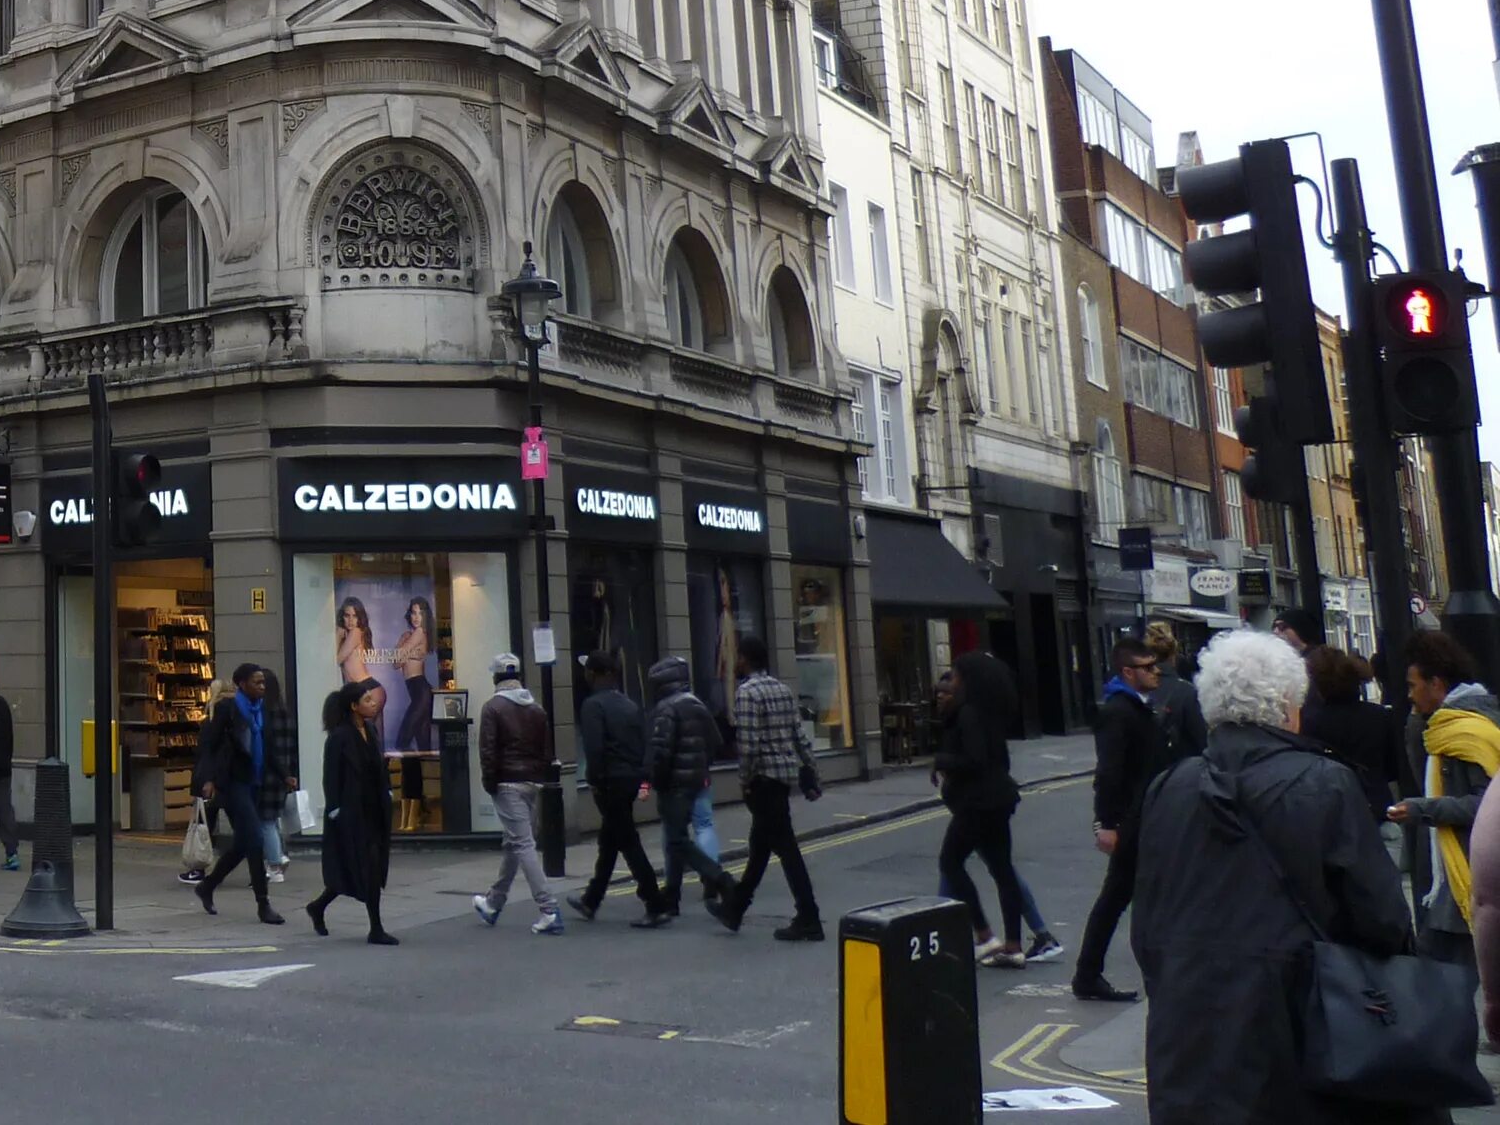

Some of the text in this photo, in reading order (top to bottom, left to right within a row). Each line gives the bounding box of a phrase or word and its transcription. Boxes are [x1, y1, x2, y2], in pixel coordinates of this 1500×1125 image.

[338, 168, 458, 234] BERWICK
[376, 218, 428, 235] 1886
[359, 240, 444, 267] HOUSE
[50, 488, 189, 525] CALNIA
[295, 483, 517, 511] CALZEDONIA
[577, 487, 656, 520] CALZEDONIA
[698, 503, 762, 533] CALZEDONIA
[253, 589, 264, 610] H
